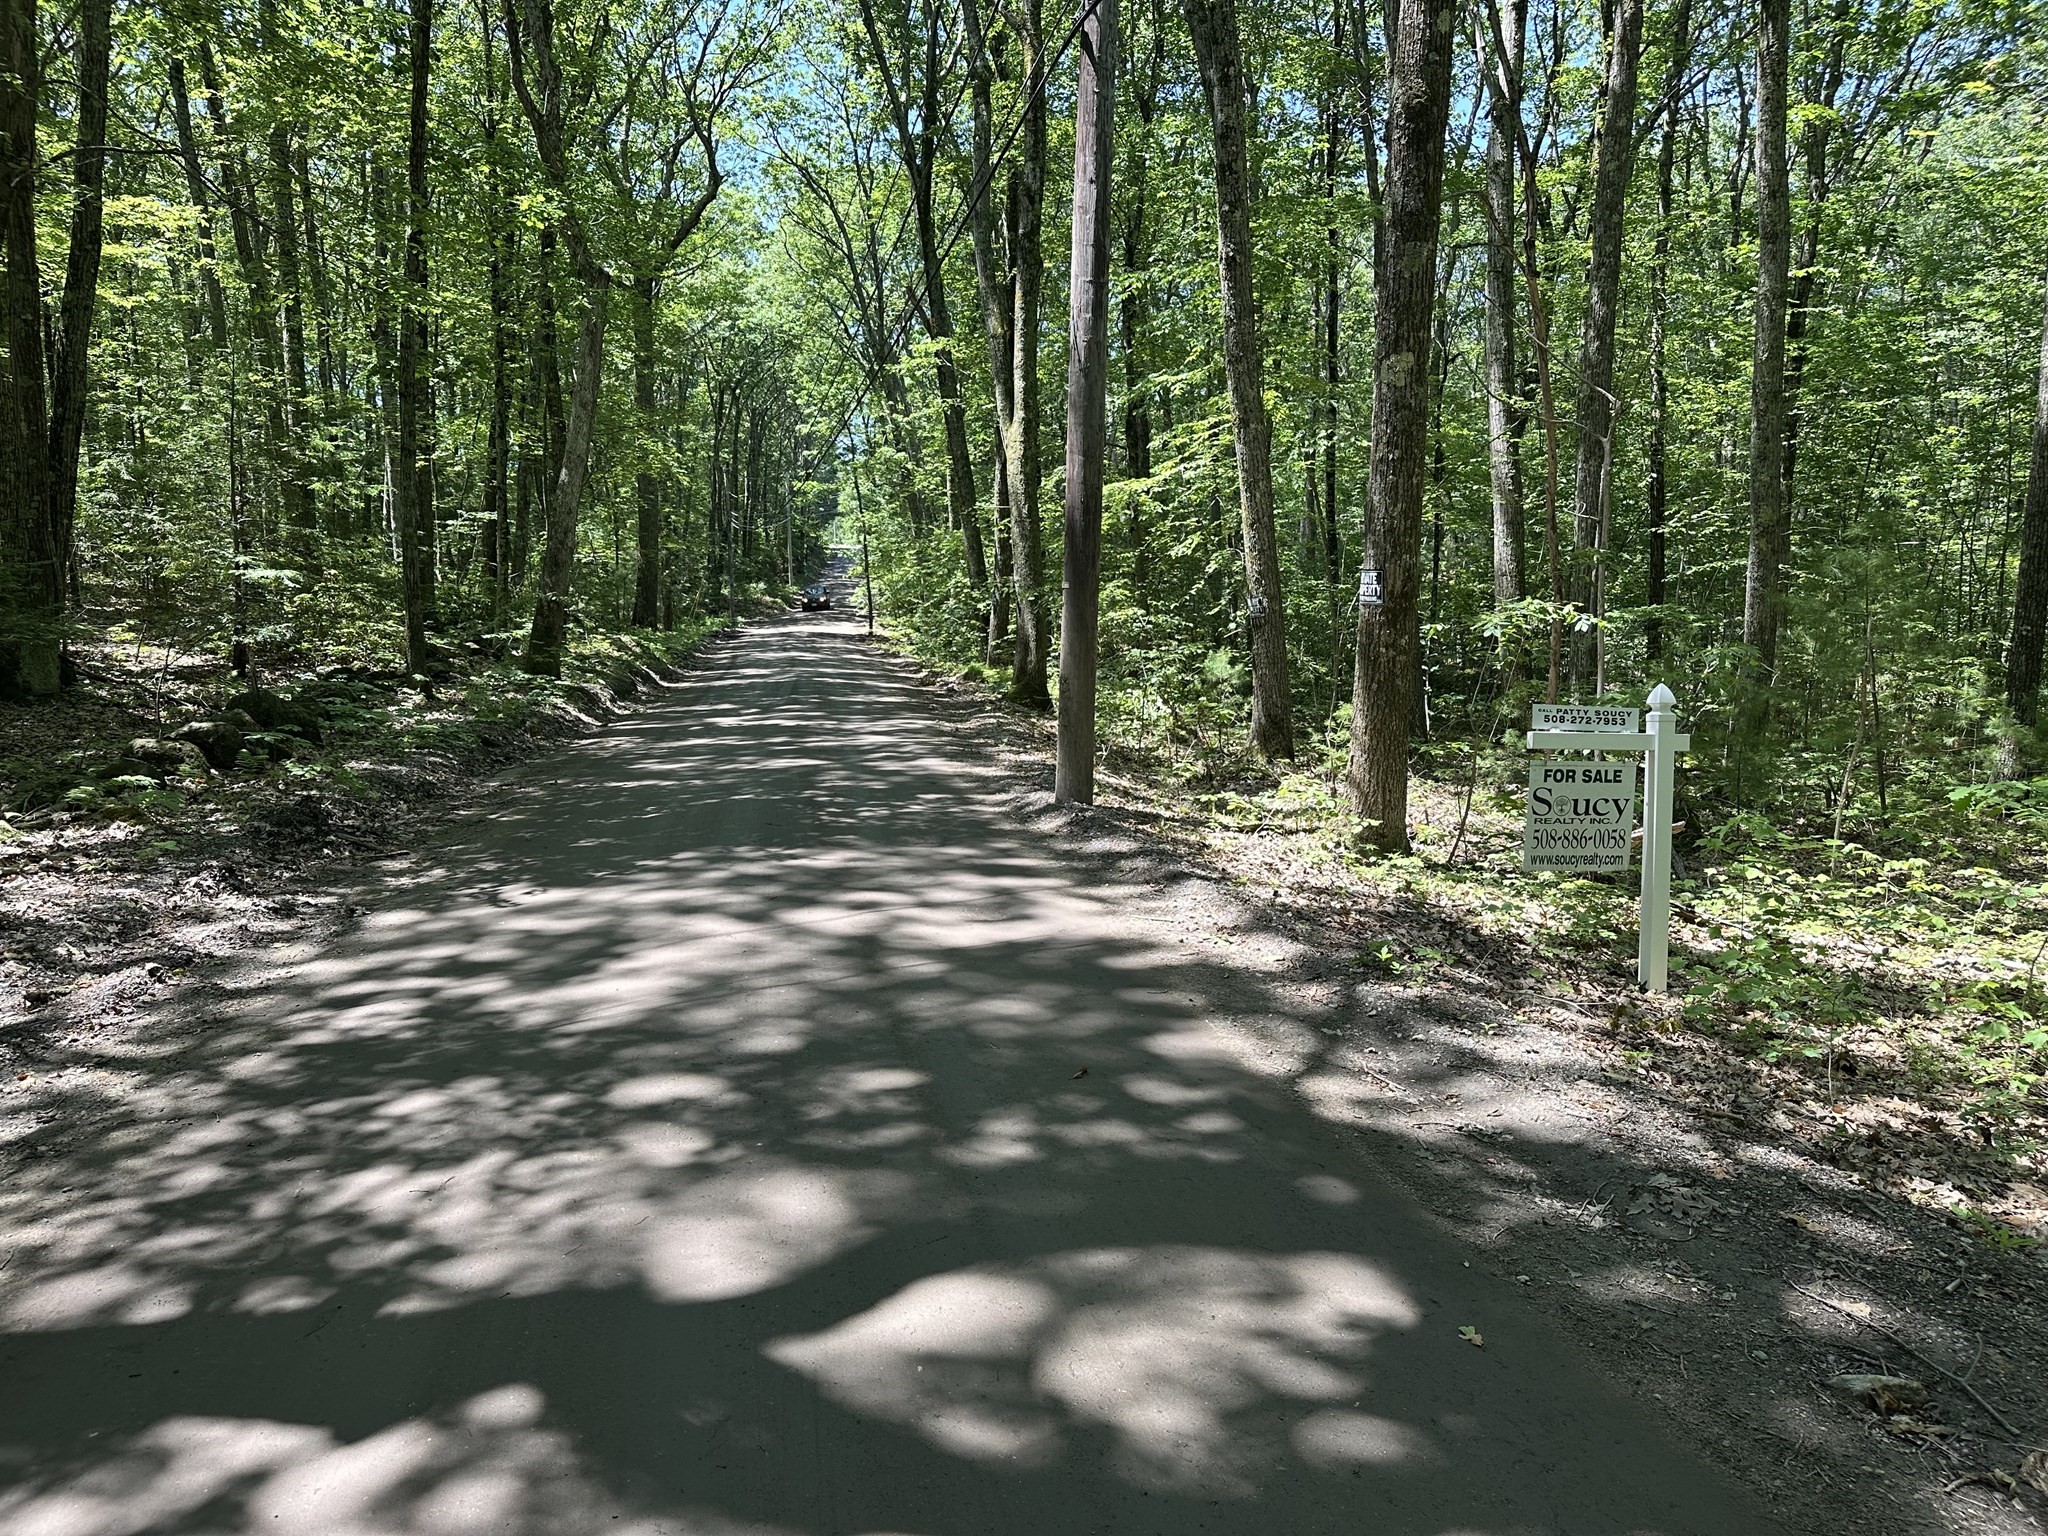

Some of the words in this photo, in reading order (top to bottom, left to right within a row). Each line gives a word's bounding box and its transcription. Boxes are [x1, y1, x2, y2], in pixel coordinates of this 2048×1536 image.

[1543, 715, 1626, 726] 508-272-7953
[1556, 708, 1589, 716] PATTY
[1594, 710, 1632, 718] SOUCY
[1543, 769, 1576, 783] FOR
[1581, 769, 1623, 784] SALE
[1531, 787, 1631, 824] Soucy
[1534, 817, 1586, 825] REALTY
[1589, 817, 1613, 825] INC.
[1531, 828, 1626, 850] 508-886-0058
[1530, 852, 1624, 868] www.soucyrealty.com
